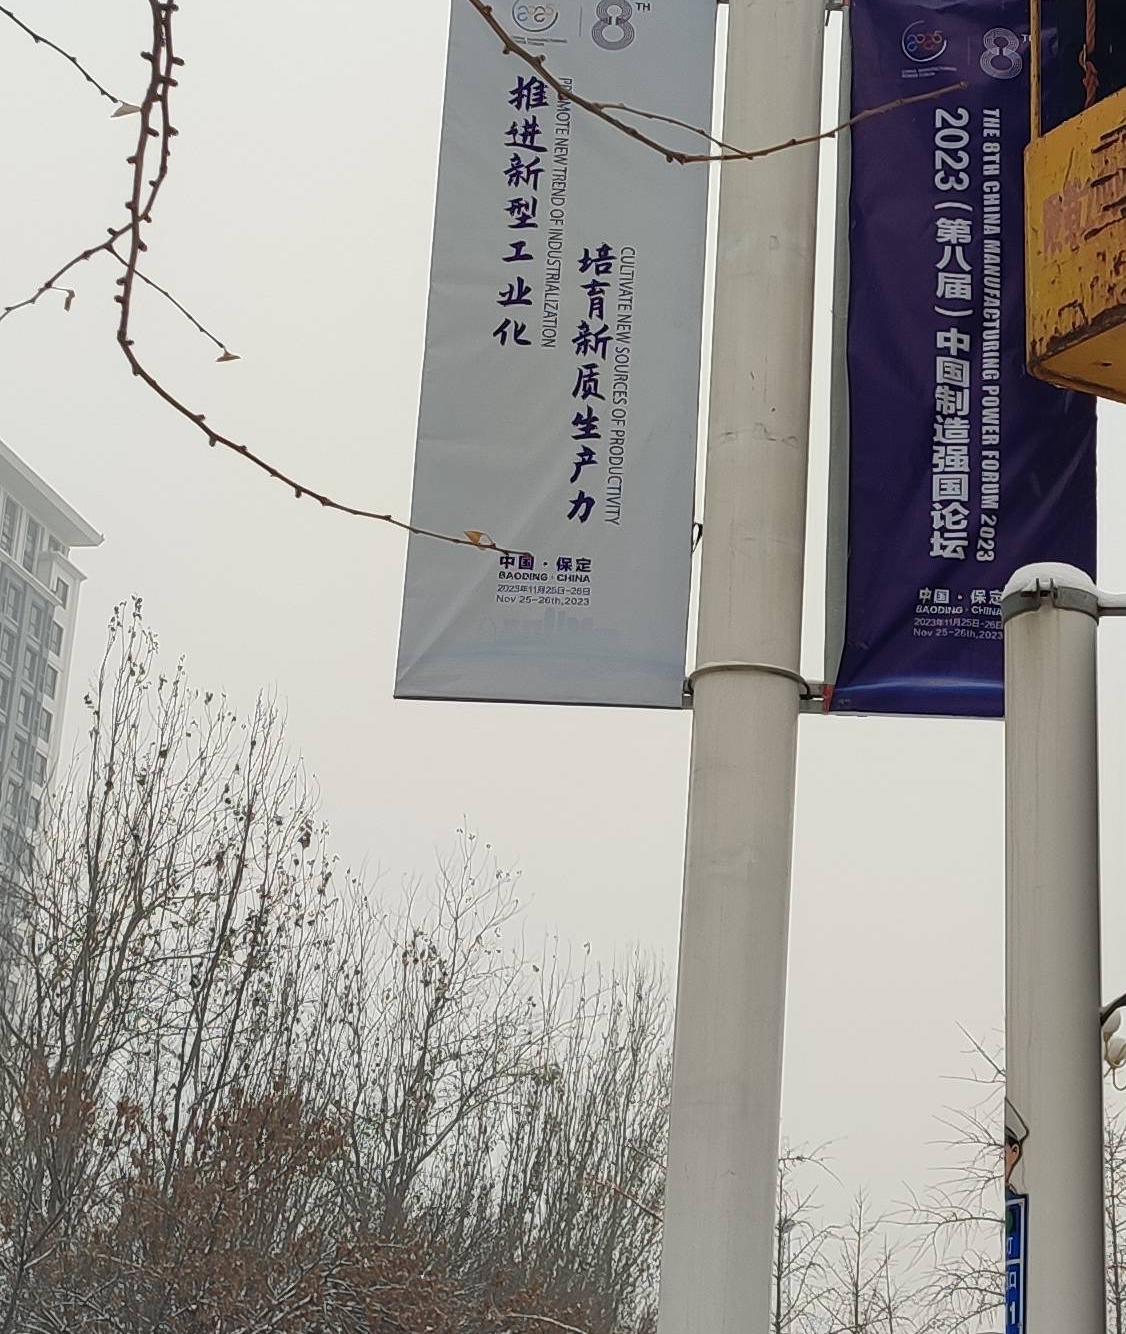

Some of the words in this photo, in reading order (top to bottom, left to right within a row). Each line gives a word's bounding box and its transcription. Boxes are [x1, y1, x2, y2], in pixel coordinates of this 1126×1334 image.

[555, 76, 573, 135] PRMOTE
[982, 108, 1000, 138] THE
[553, 138, 570, 166] NEW
[982, 142, 1001, 176] 8TH
[492, 75, 549, 347] 推进新型工业化
[550, 167, 567, 207] TREND
[982, 180, 1001, 235] CHINA
[549, 208, 565, 226] OF
[541, 228, 564, 348] INDUSTRIALIZATION
[617, 246, 636, 311] CULTIVATE
[615, 314, 632, 345] NEW
[982, 239, 1001, 381] MANUFACTURING
[566, 242, 617, 524] 培育新质生产力
[612, 346, 631, 405] SOURCES
[610, 408, 627, 427] OF
[981, 385, 1000, 445] POWER
[604, 429, 626, 526] PRODUCTIVITY
[981, 450, 1000, 509] FORUM
[976, 513, 998, 562] 2023
[496, 595, 516, 604] Nov
[498, 571, 548, 582] BAODING
[556, 573, 591, 583] CHINA
[912, 628, 933, 637] Nov
[915, 605, 963, 615] BAODING
